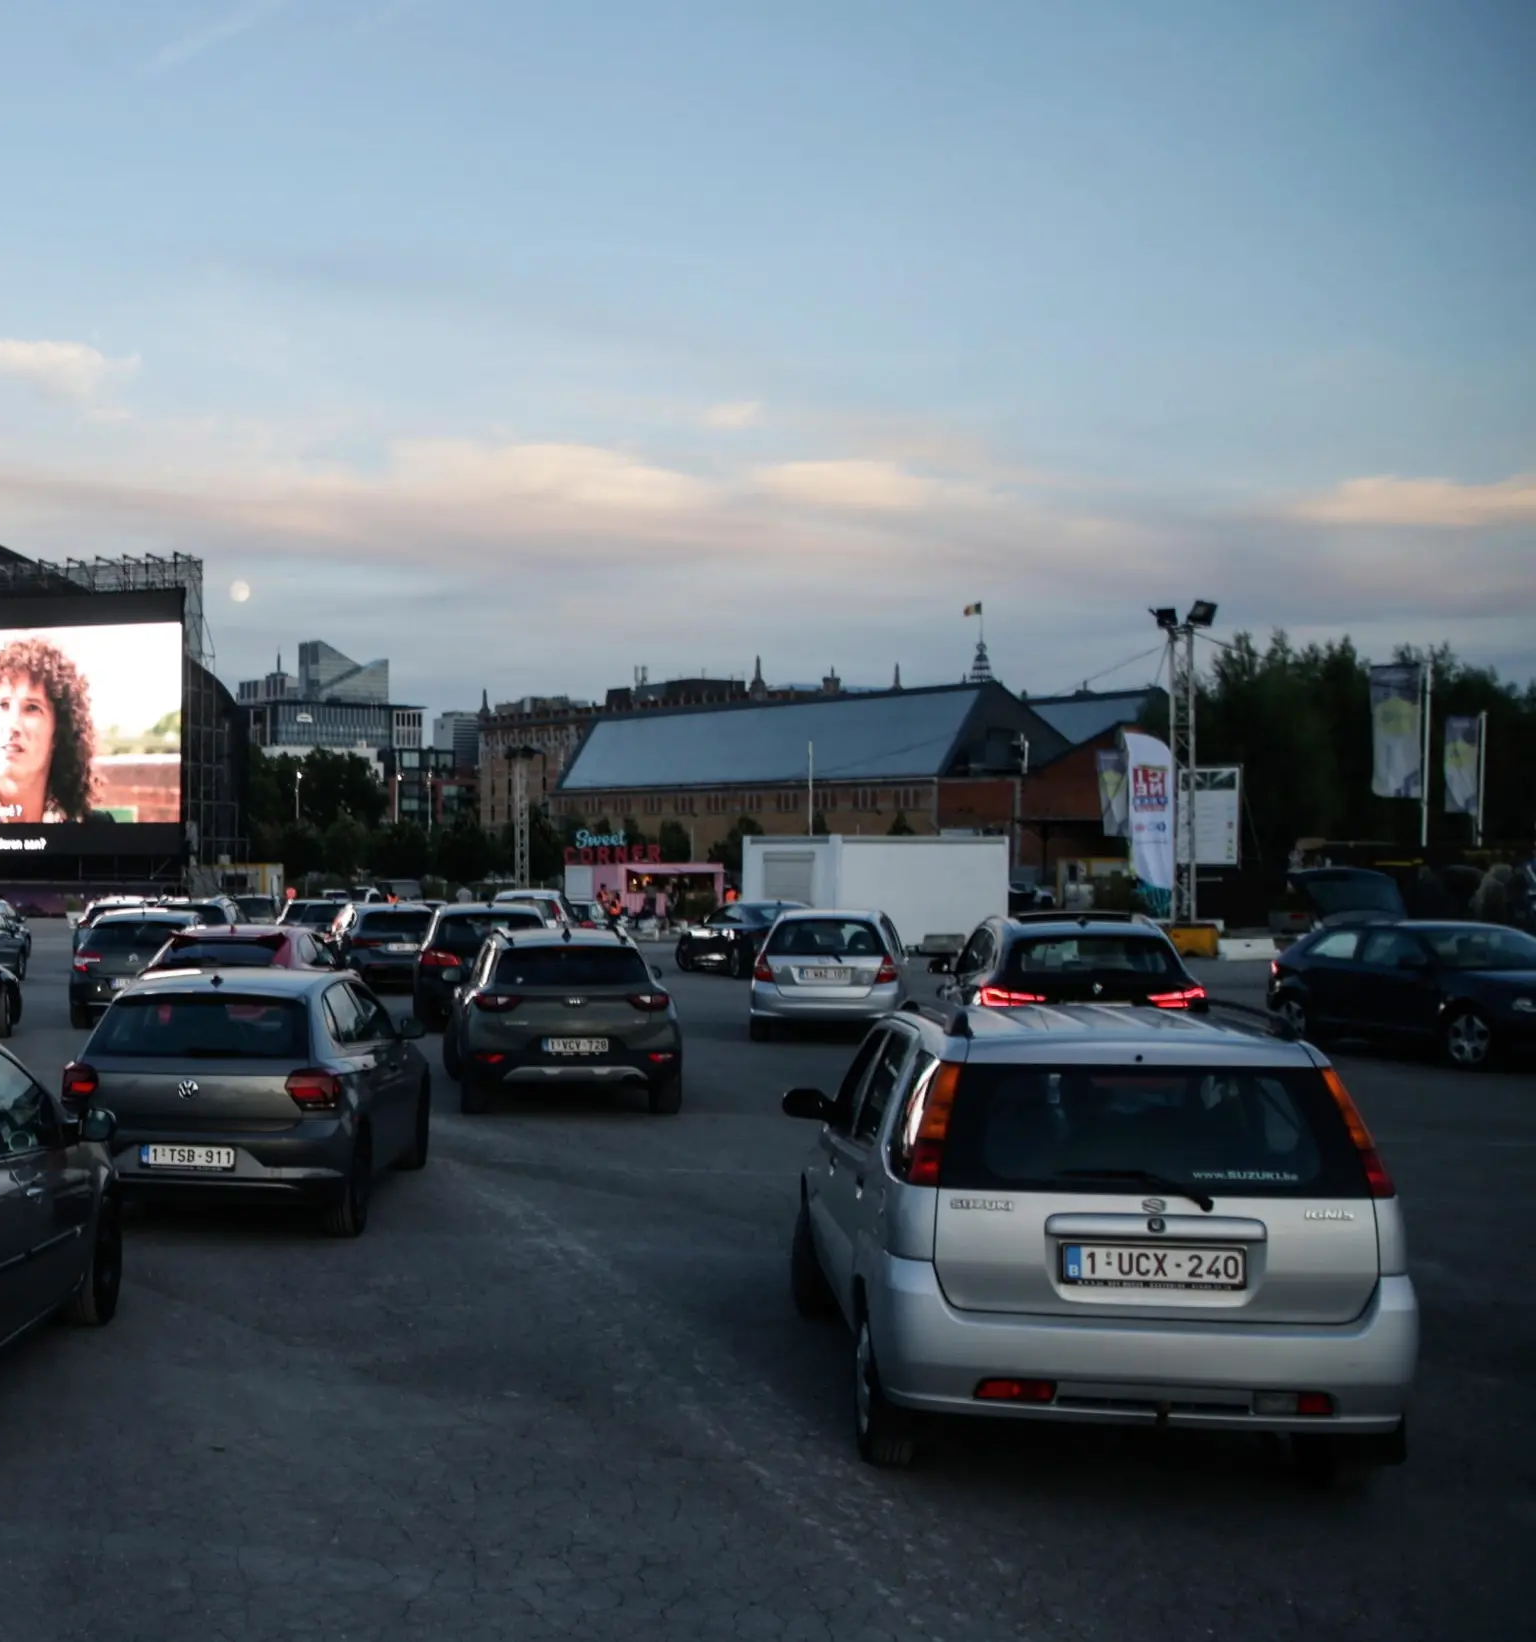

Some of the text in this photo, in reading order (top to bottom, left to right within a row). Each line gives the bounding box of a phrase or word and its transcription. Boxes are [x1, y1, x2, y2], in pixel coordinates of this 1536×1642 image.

[575, 828, 628, 848] Sweet
[564, 844, 662, 864] CORNER
[950, 1198, 1015, 1212] SUZUKI
[1304, 1208, 1355, 1221] IGNIS
